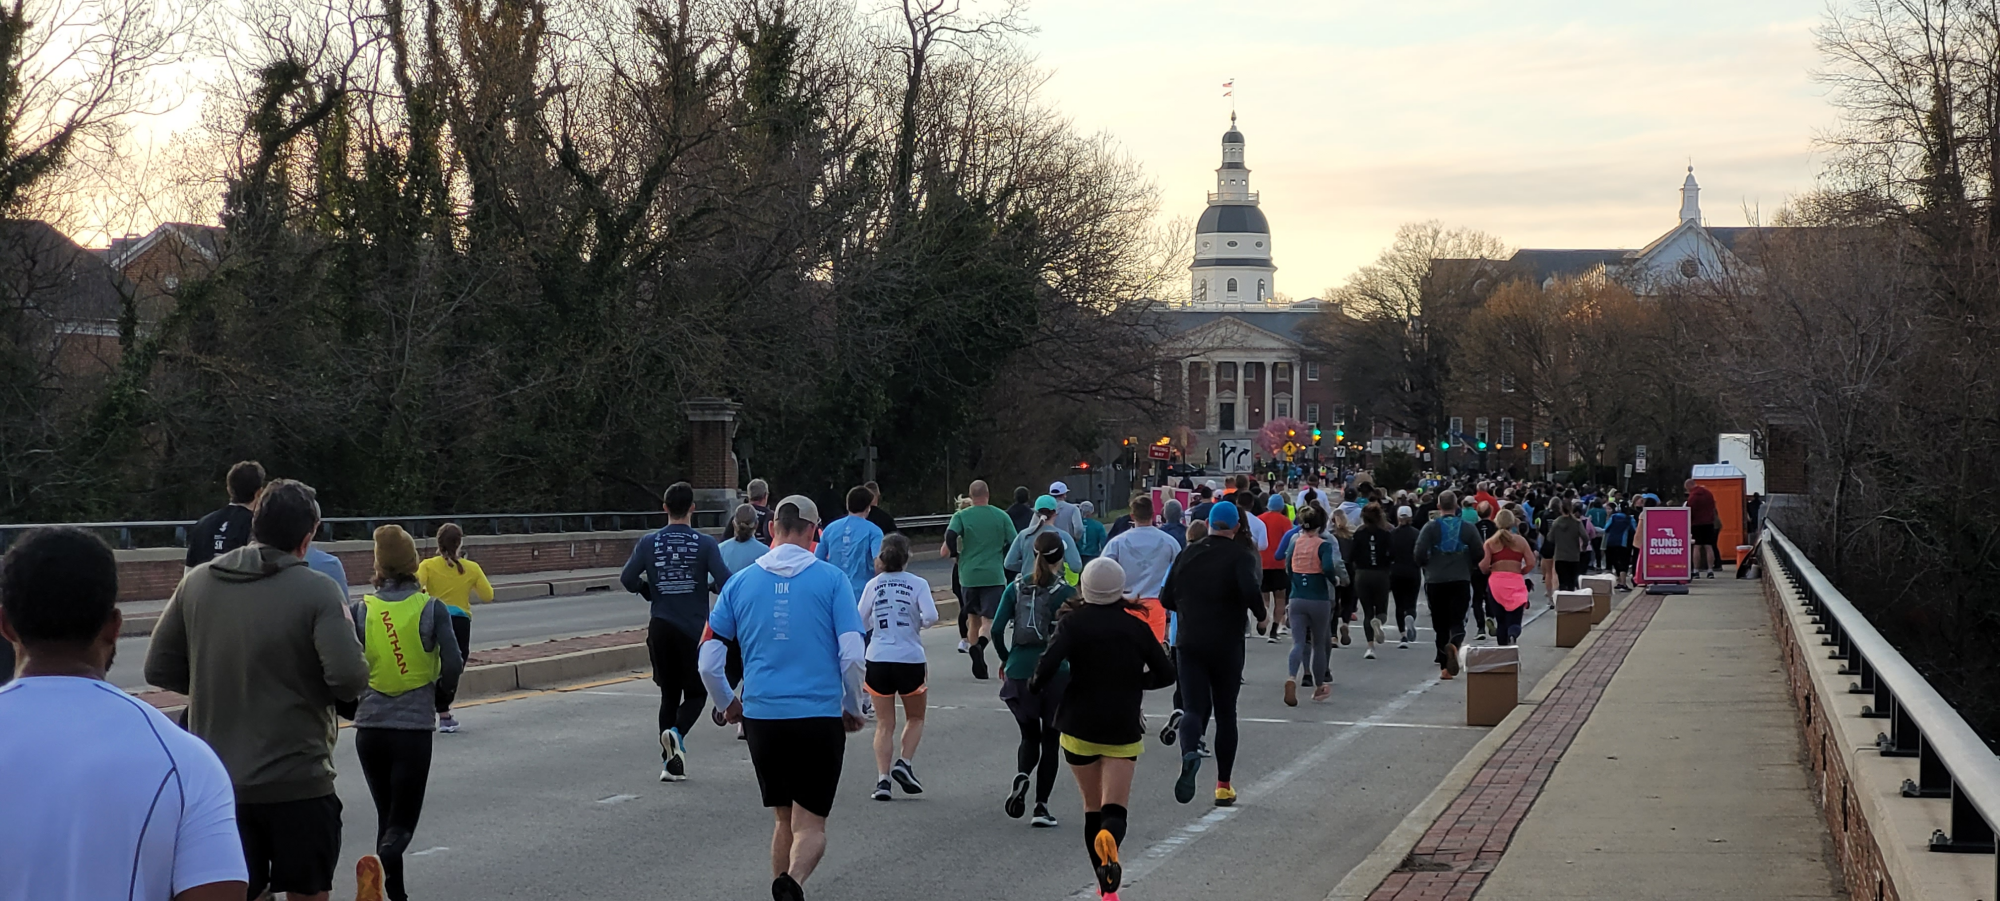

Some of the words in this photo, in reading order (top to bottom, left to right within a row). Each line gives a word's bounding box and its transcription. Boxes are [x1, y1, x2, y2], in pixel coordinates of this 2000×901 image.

[1650, 538, 1678, 547] RUNS
[774, 582, 790, 594] 10K
[380, 611, 409, 676] NATHAN
